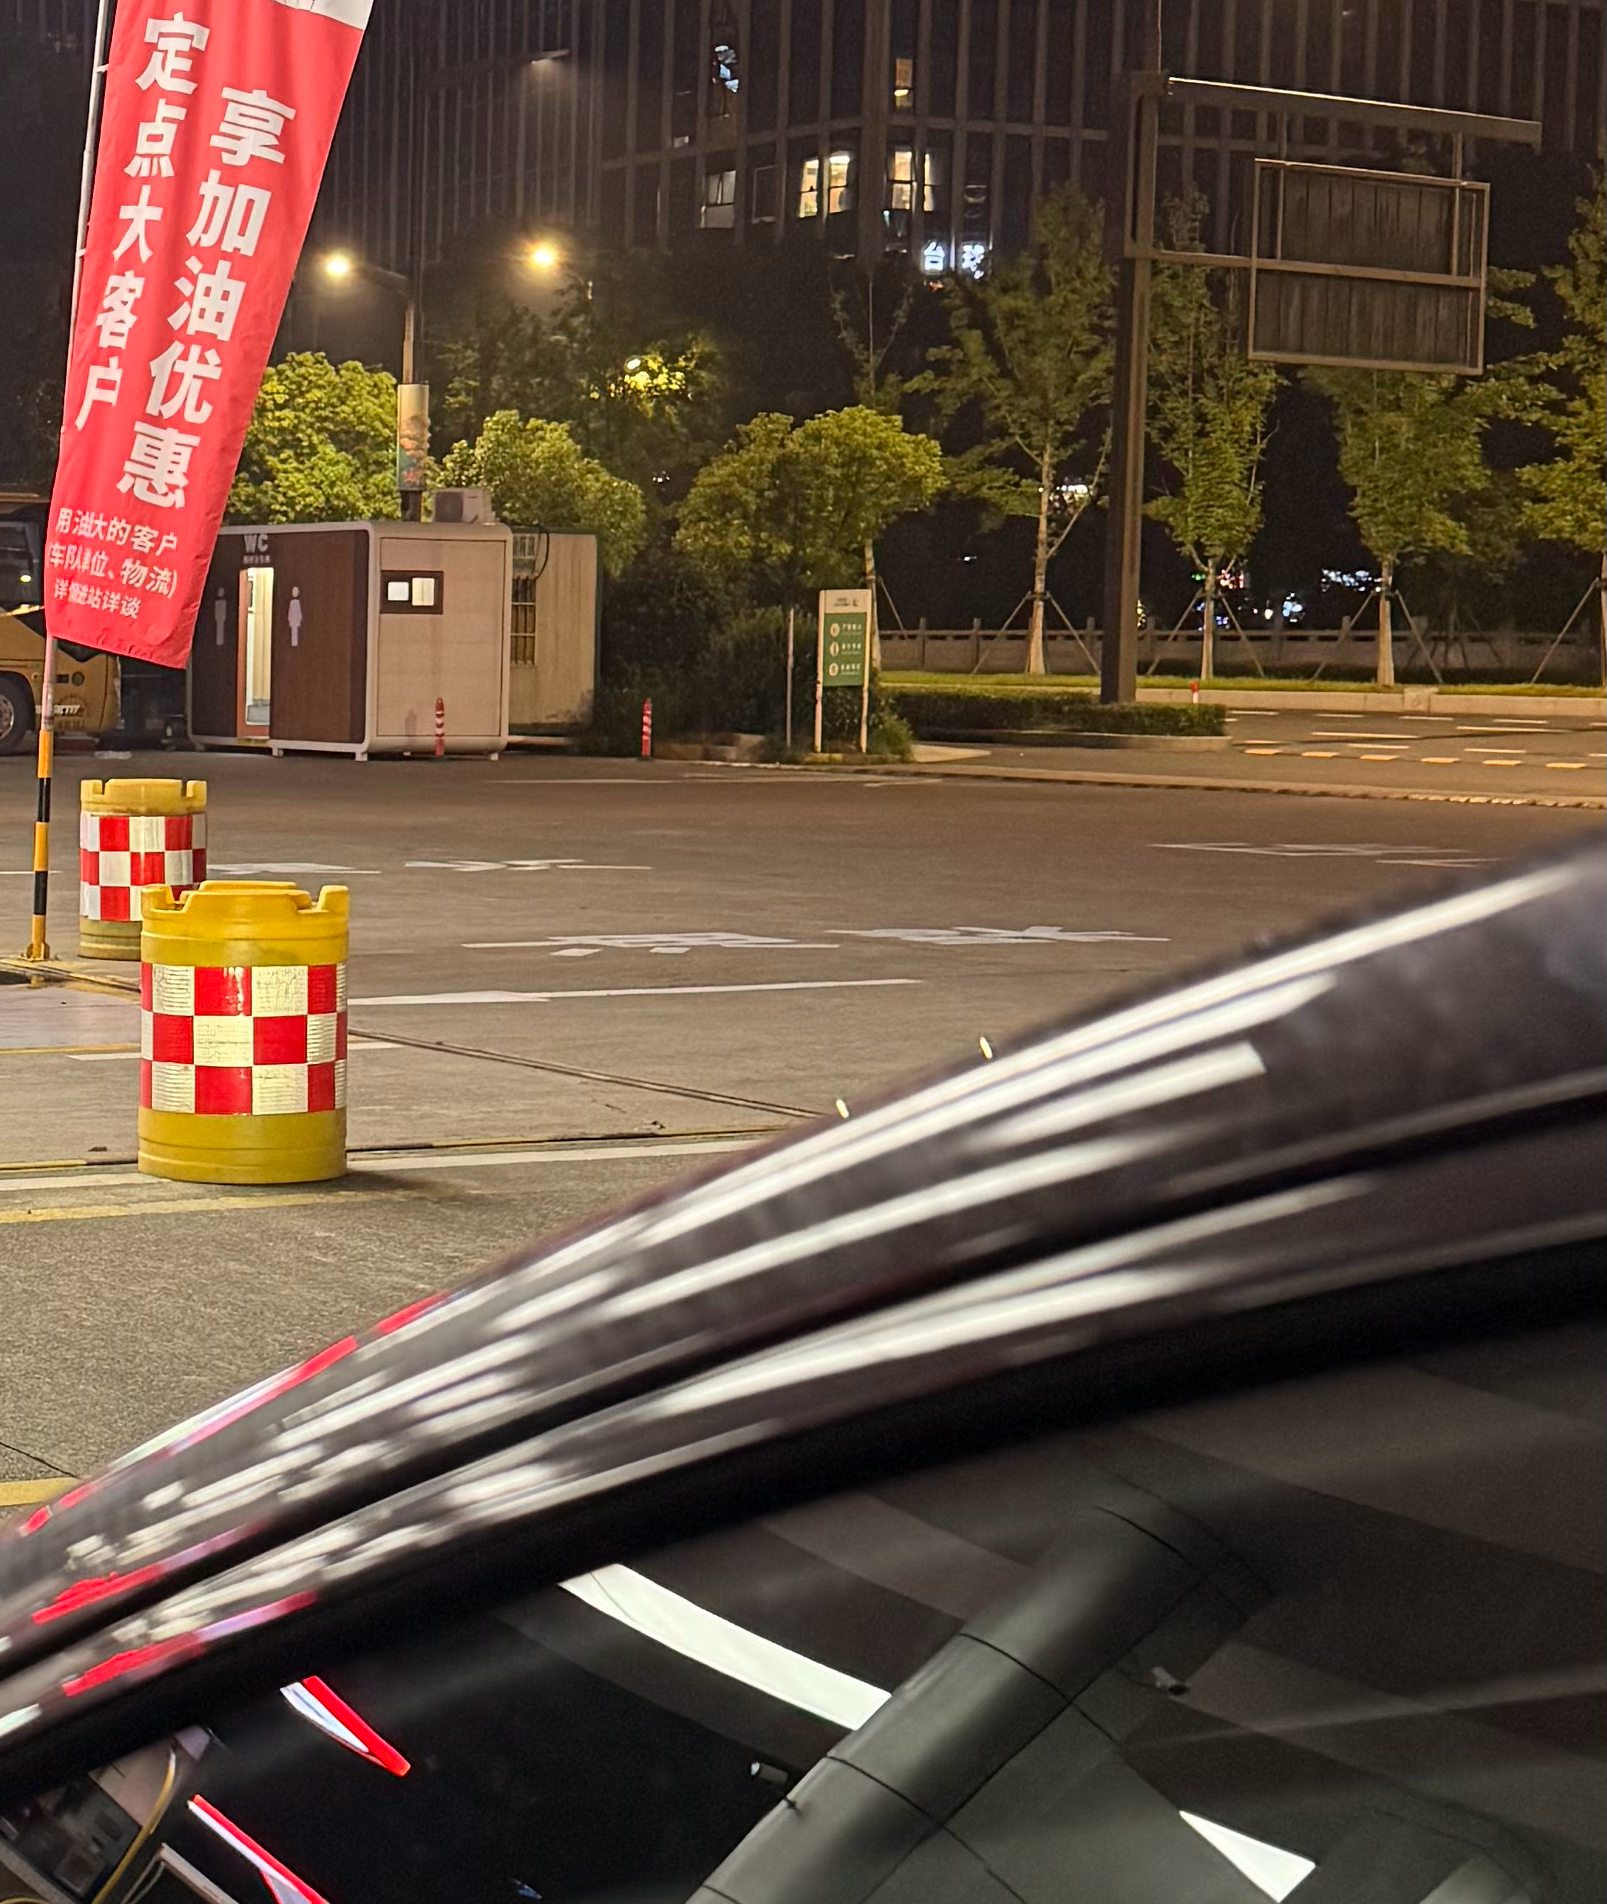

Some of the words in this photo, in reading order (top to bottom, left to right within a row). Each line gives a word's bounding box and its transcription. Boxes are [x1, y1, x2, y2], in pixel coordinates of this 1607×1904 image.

[75, 11, 210, 431] 定点大客户
[117, 86, 296, 510] 享加油优惠
[244, 534, 269, 553] WC
